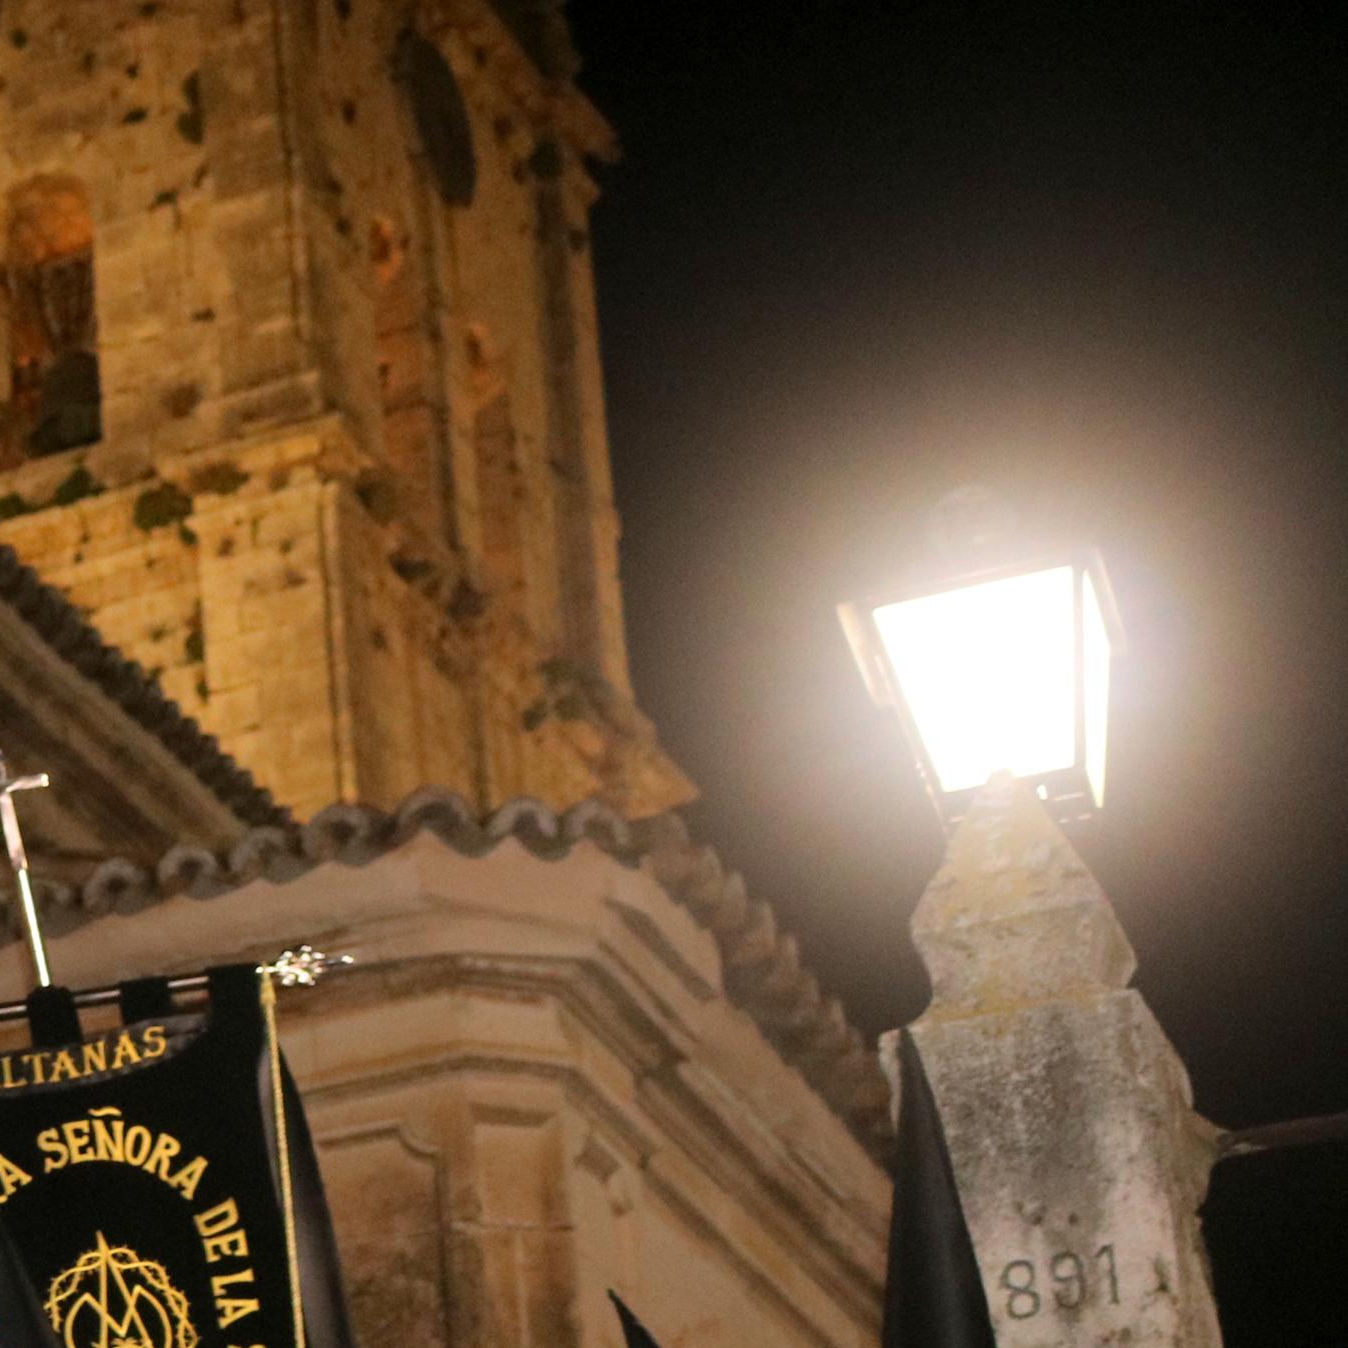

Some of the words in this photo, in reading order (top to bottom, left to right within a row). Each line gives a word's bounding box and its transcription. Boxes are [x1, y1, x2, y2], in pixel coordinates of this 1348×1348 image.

[37, 1105, 209, 1200] SEÑORA
[192, 1196, 249, 1263] DE
[211, 1267, 260, 1329] LA
